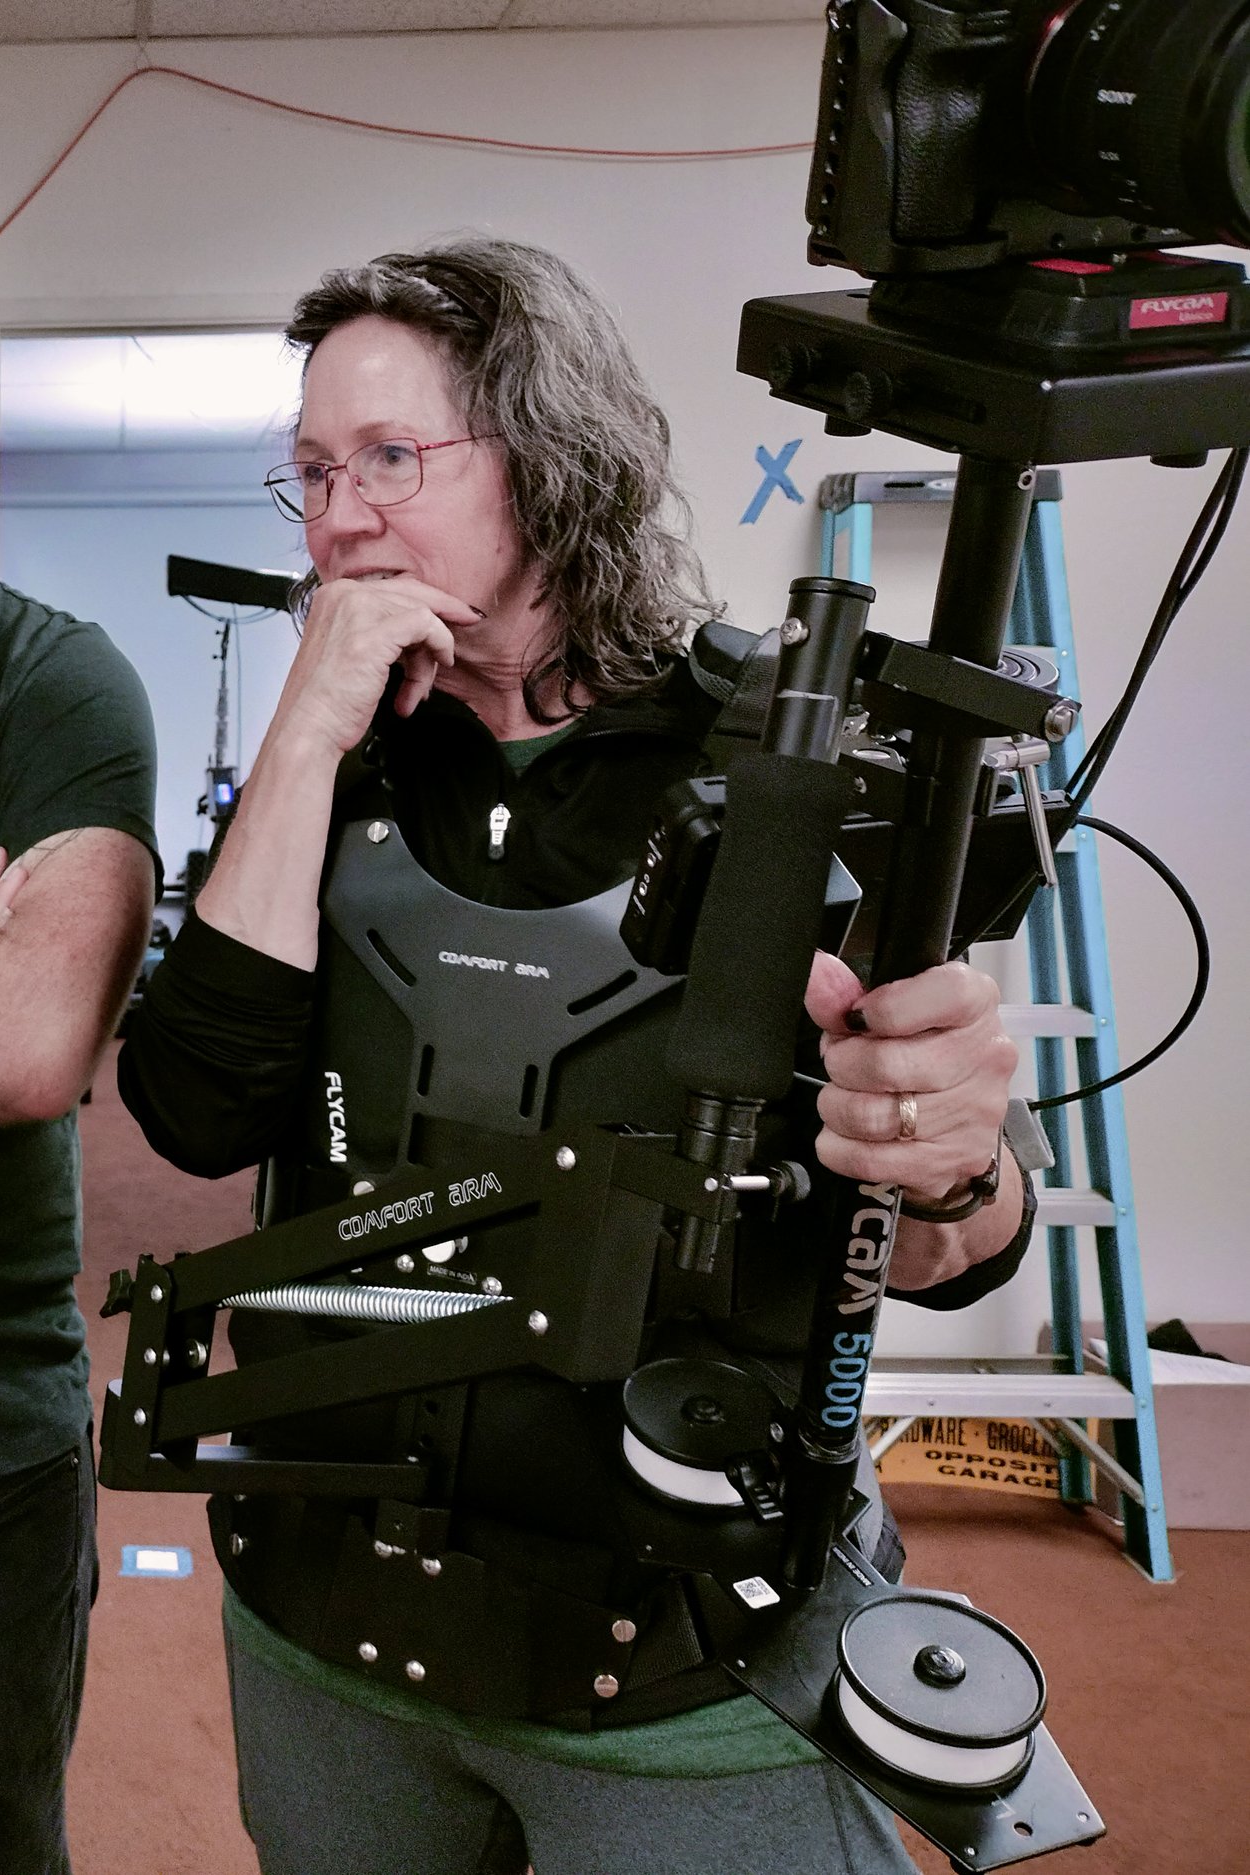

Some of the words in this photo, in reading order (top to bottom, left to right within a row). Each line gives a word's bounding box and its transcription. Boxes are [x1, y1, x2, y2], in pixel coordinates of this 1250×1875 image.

[1097, 88, 1137, 105] SONY
[438, 950, 509, 972] COMFORT
[324, 1071, 348, 1163] FLYCAM
[338, 1192, 435, 1241] COMFORT
[821, 1332, 872, 1428] 5000
[925, 1449, 1059, 1475] OPPOSIT
[938, 1465, 1060, 1490] GARAGE
